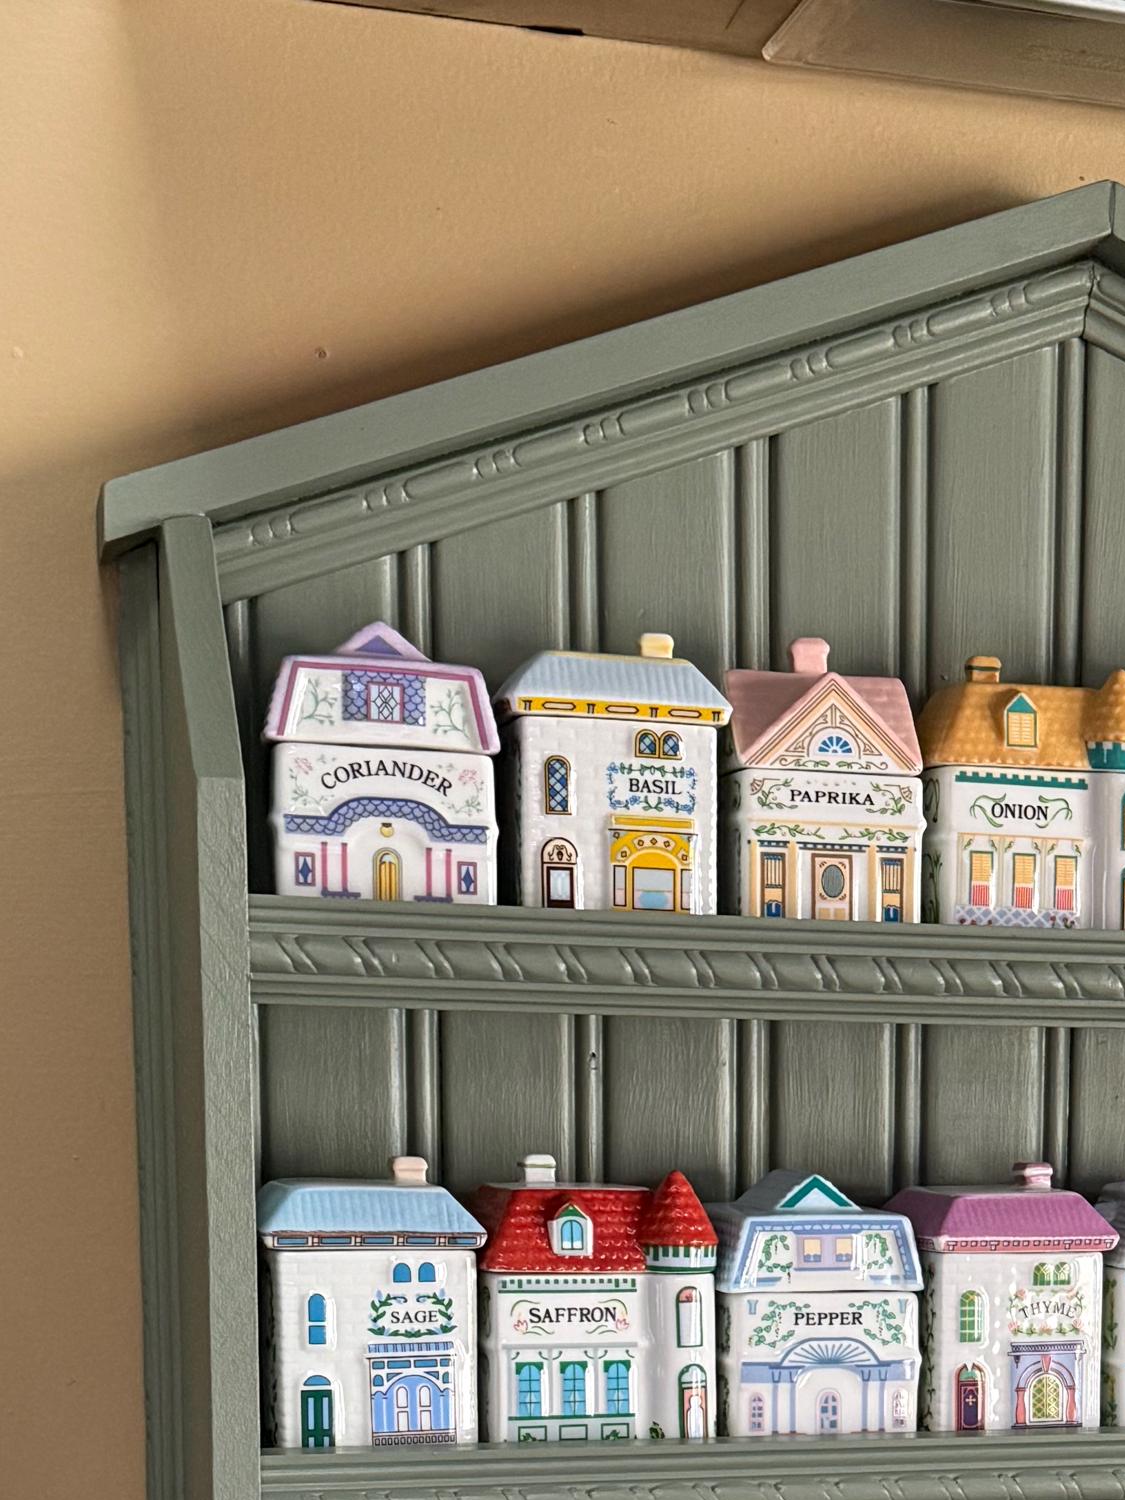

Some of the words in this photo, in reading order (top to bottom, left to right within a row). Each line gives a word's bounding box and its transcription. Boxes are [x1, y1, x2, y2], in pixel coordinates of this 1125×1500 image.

[320, 759, 452, 797] CORIANDER
[628, 778, 682, 795] BASIL
[790, 789, 875, 806] PAPRIKA
[992, 803, 1049, 821] ONION
[391, 1309, 439, 1325] SAGE
[528, 1307, 617, 1325] SAFFRON
[1019, 1300, 1078, 1320] THYME
[794, 1312, 863, 1326] PEPPER
